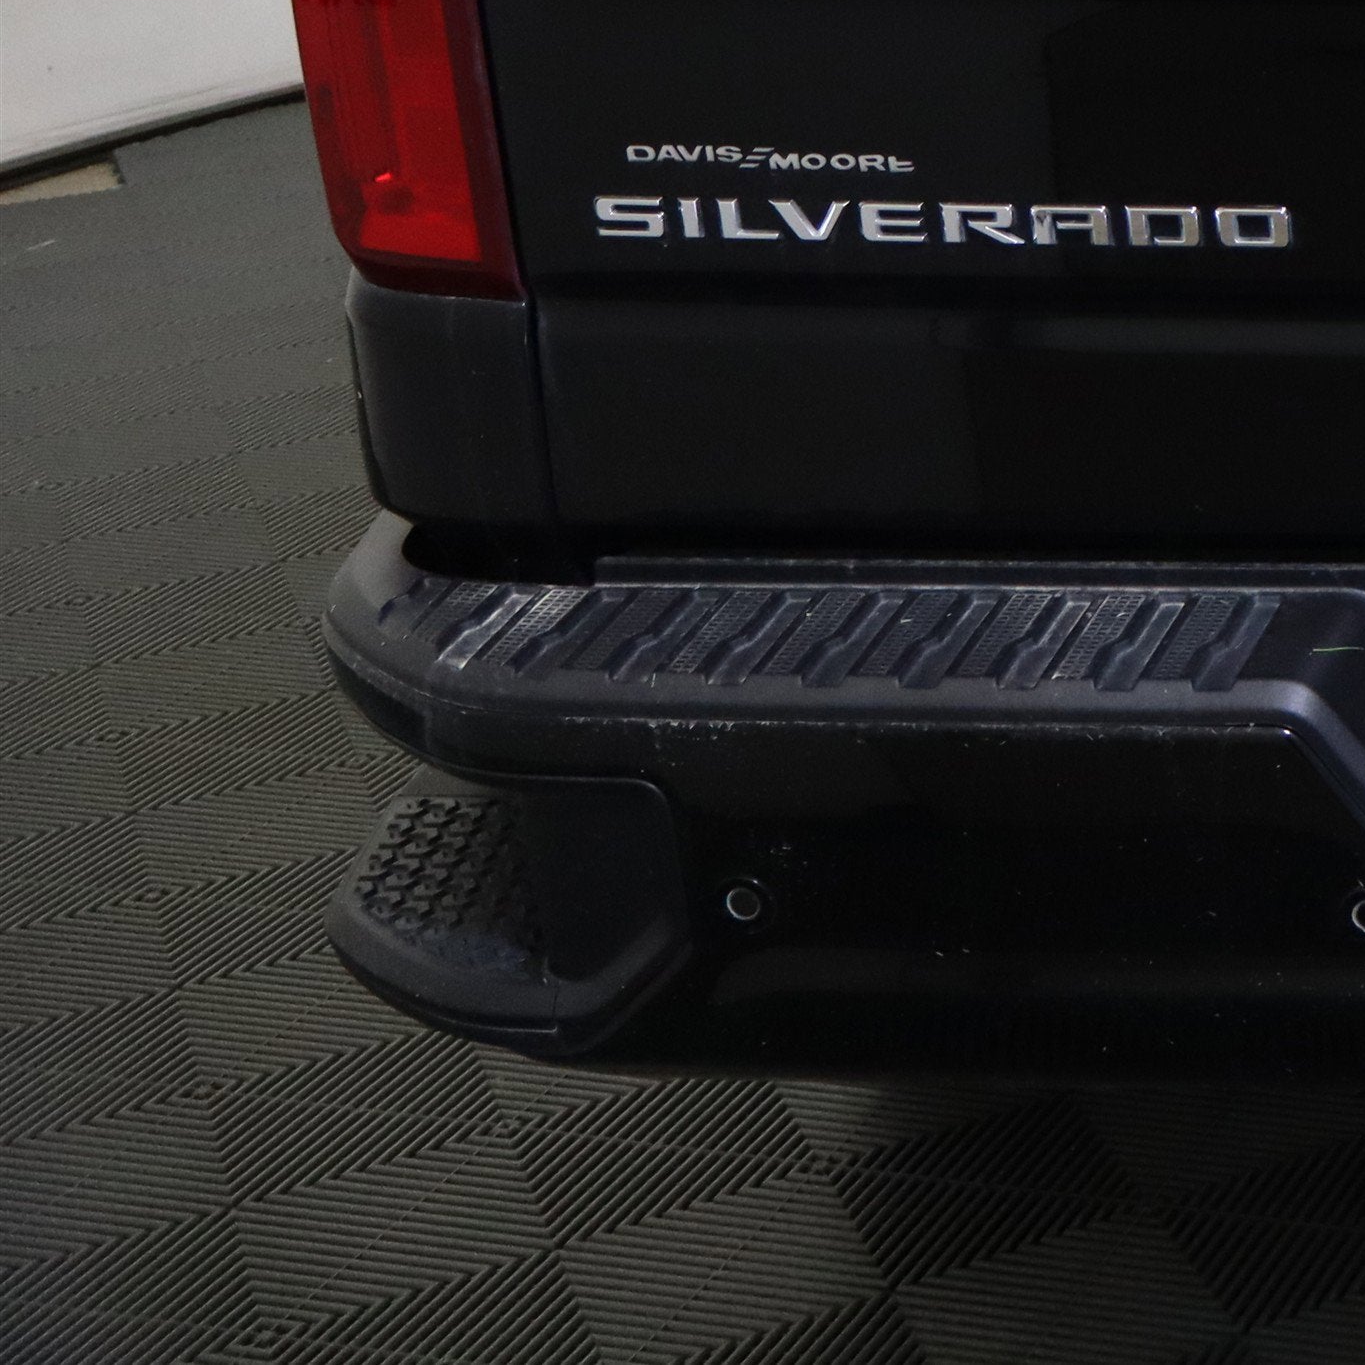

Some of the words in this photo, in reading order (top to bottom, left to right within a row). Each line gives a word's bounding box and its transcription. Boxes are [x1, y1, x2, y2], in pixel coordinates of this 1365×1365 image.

[626, 144, 744, 162] DAVIS
[768, 152, 915, 172] MOORE
[593, 195, 1293, 247] SILVERADO
